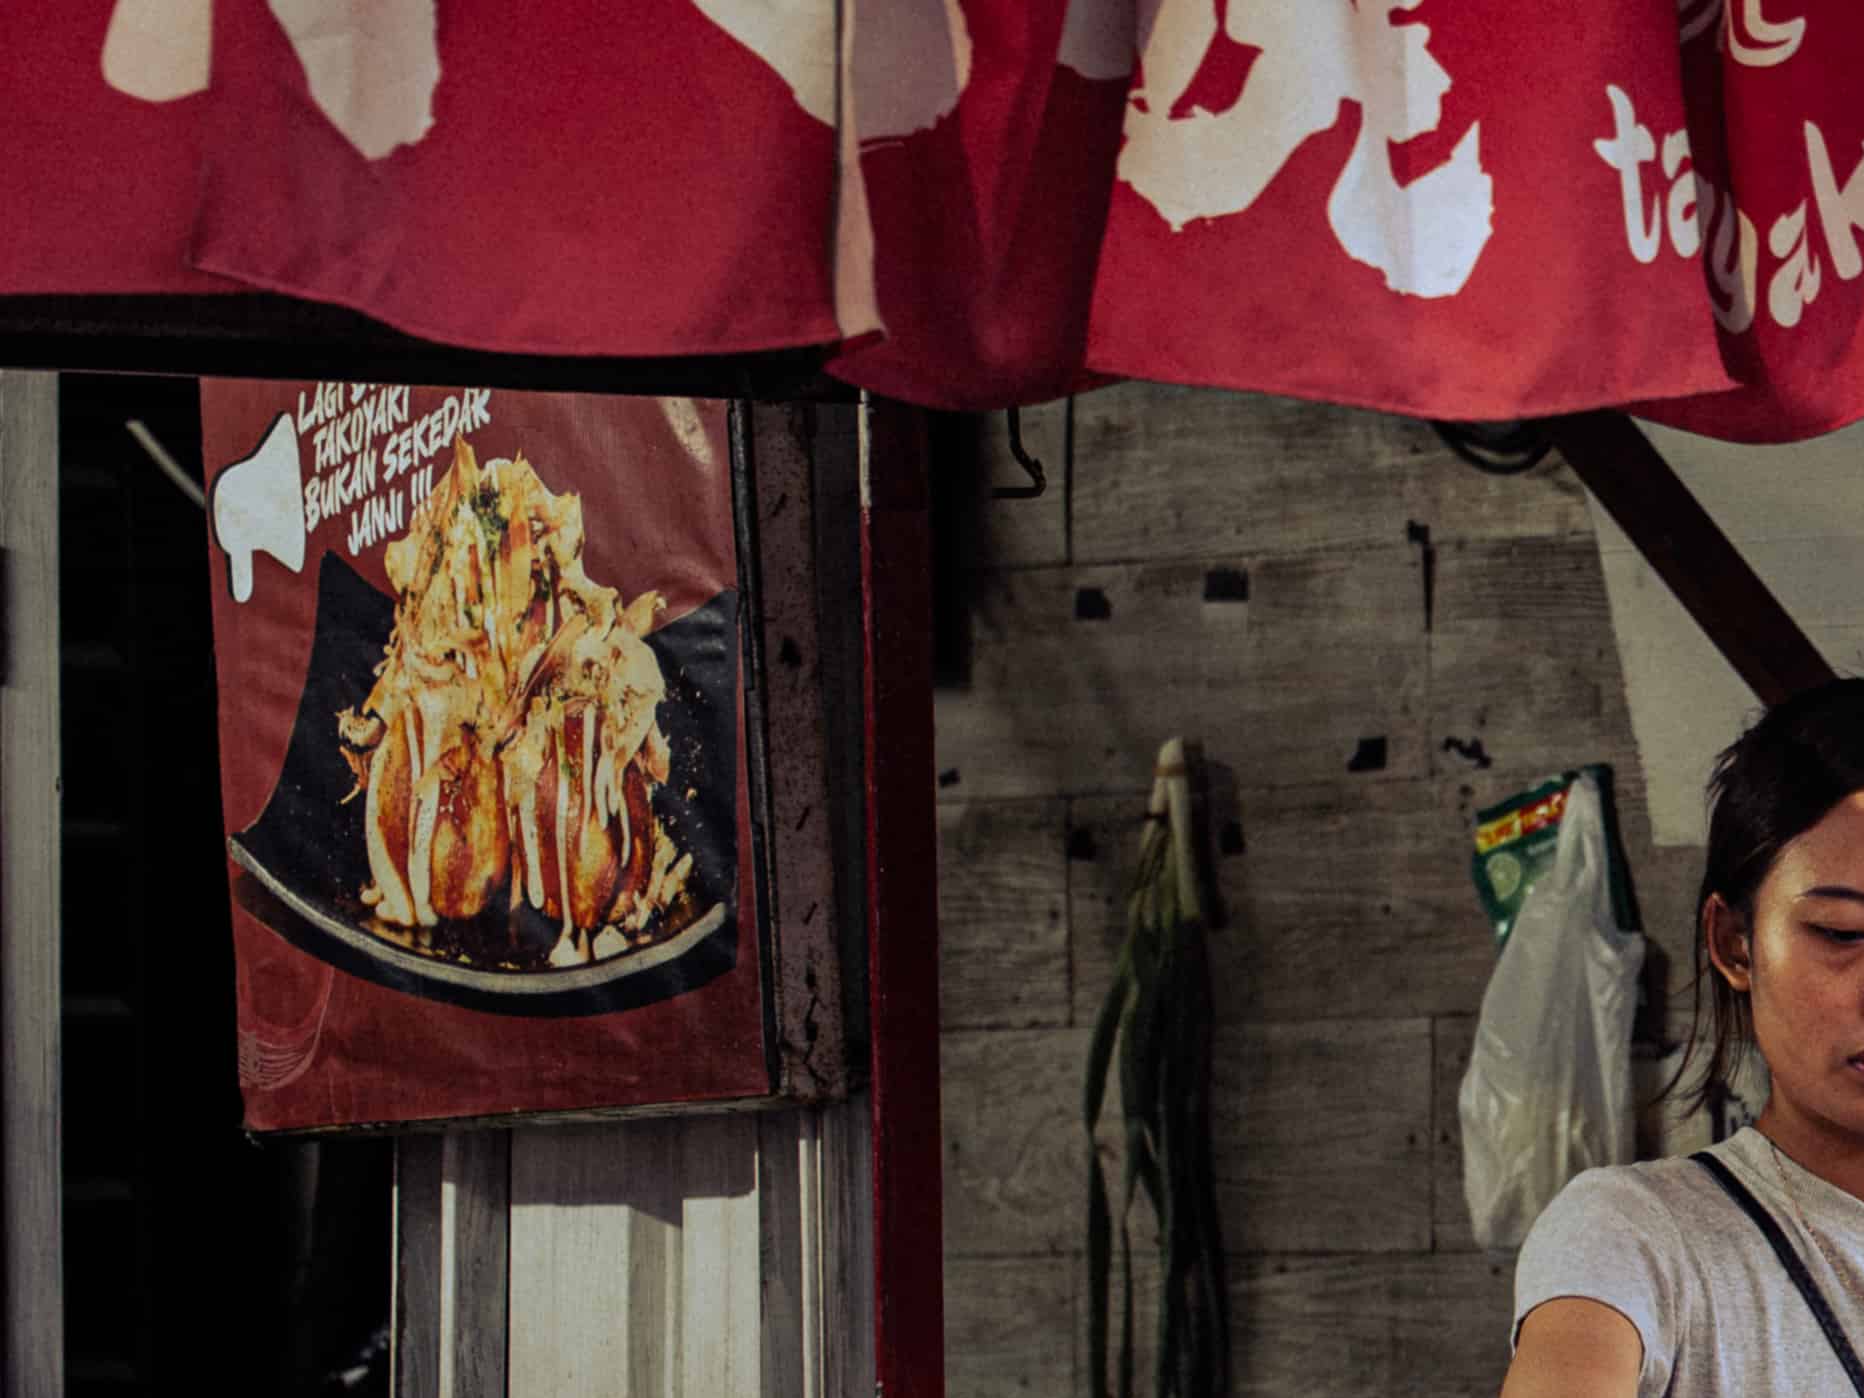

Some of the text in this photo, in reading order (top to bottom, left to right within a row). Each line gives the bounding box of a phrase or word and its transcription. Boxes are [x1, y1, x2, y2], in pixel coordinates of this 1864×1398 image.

[312, 384, 411, 474] TAKOYAKI
[304, 447, 378, 533] BUKAN
[347, 487, 405, 557] JANJI
